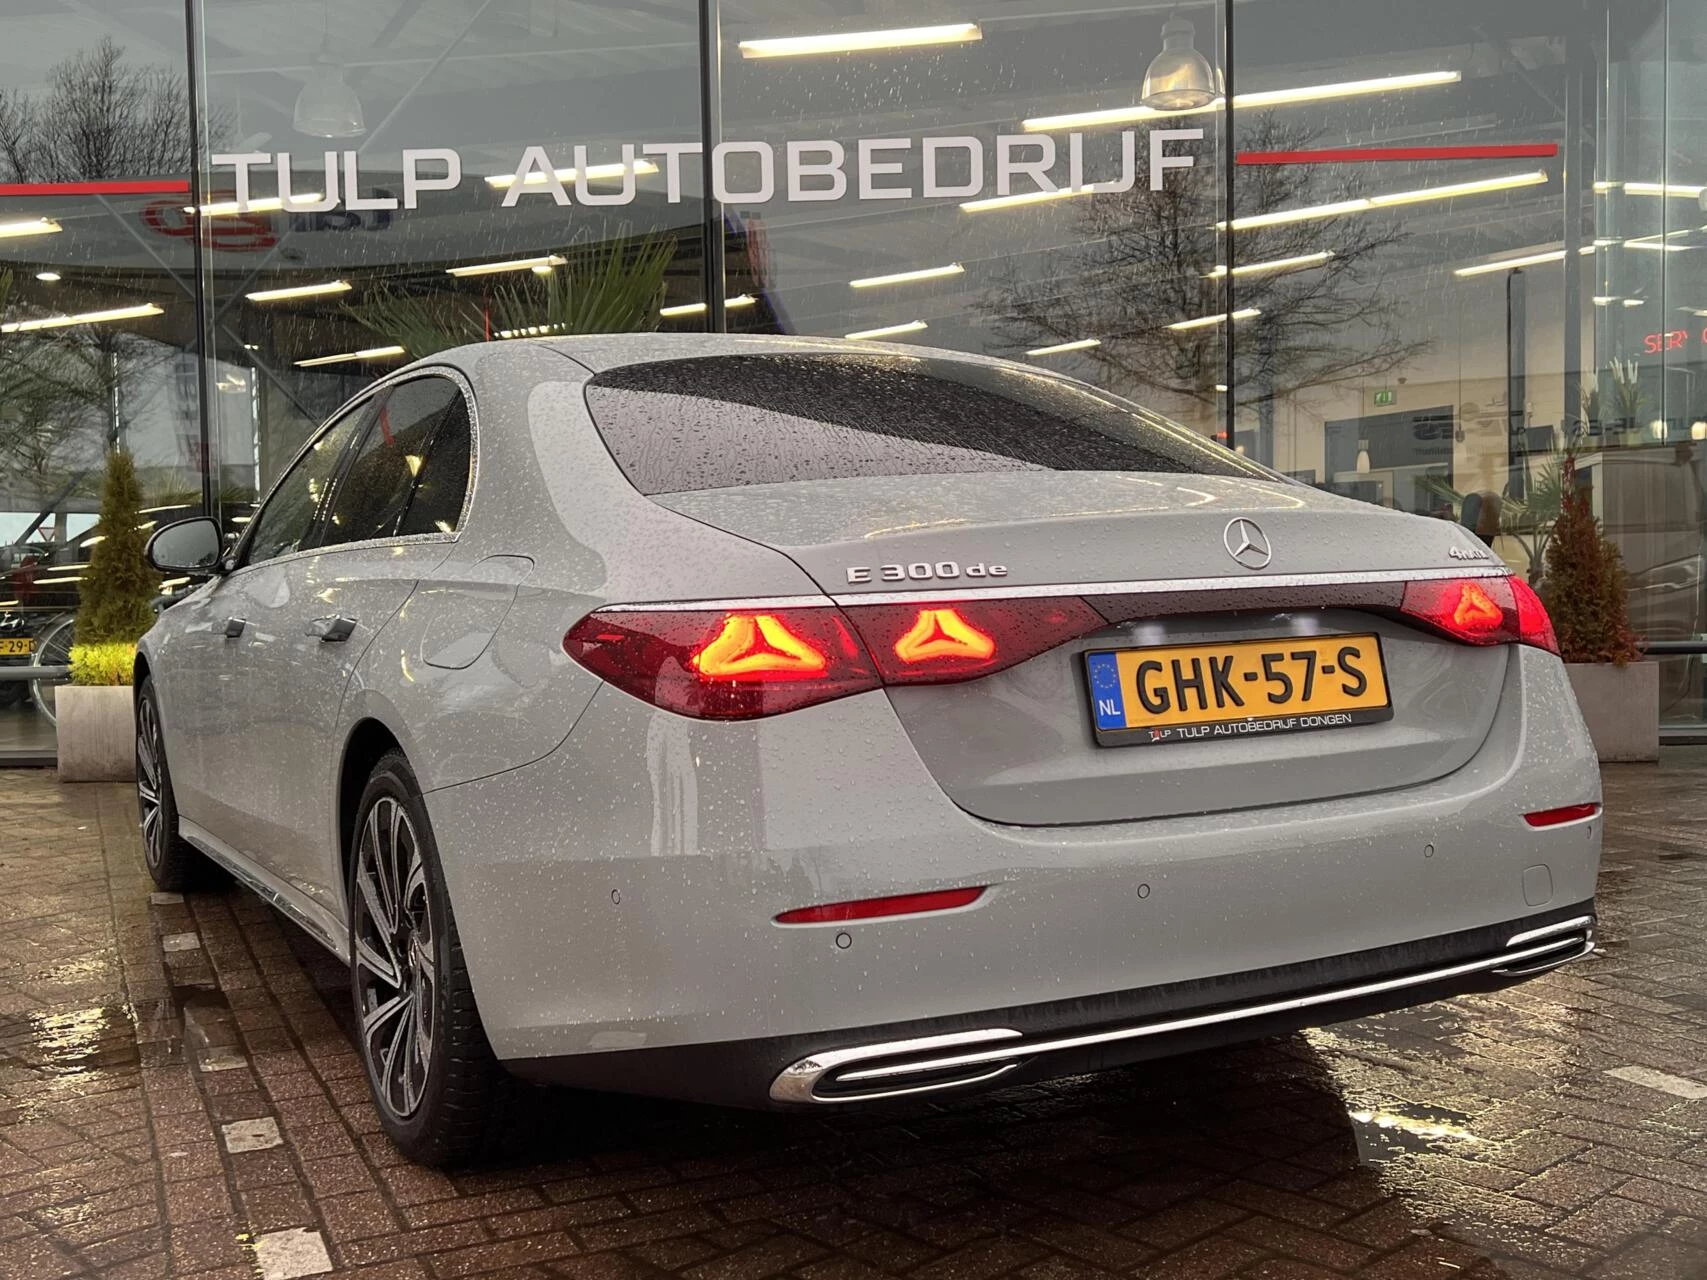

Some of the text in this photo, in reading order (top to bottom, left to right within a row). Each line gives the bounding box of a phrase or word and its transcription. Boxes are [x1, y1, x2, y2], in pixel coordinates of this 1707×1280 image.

[211, 128, 1204, 212] TULP AUTOBEDRIJF
[846, 561, 1008, 584] E 300 de
[1136, 646, 1367, 714] GHK-57-S
[1099, 699, 1121, 716] NL
[1177, 713, 1352, 739] TULP AUTOBEDRIJF DONGEN
